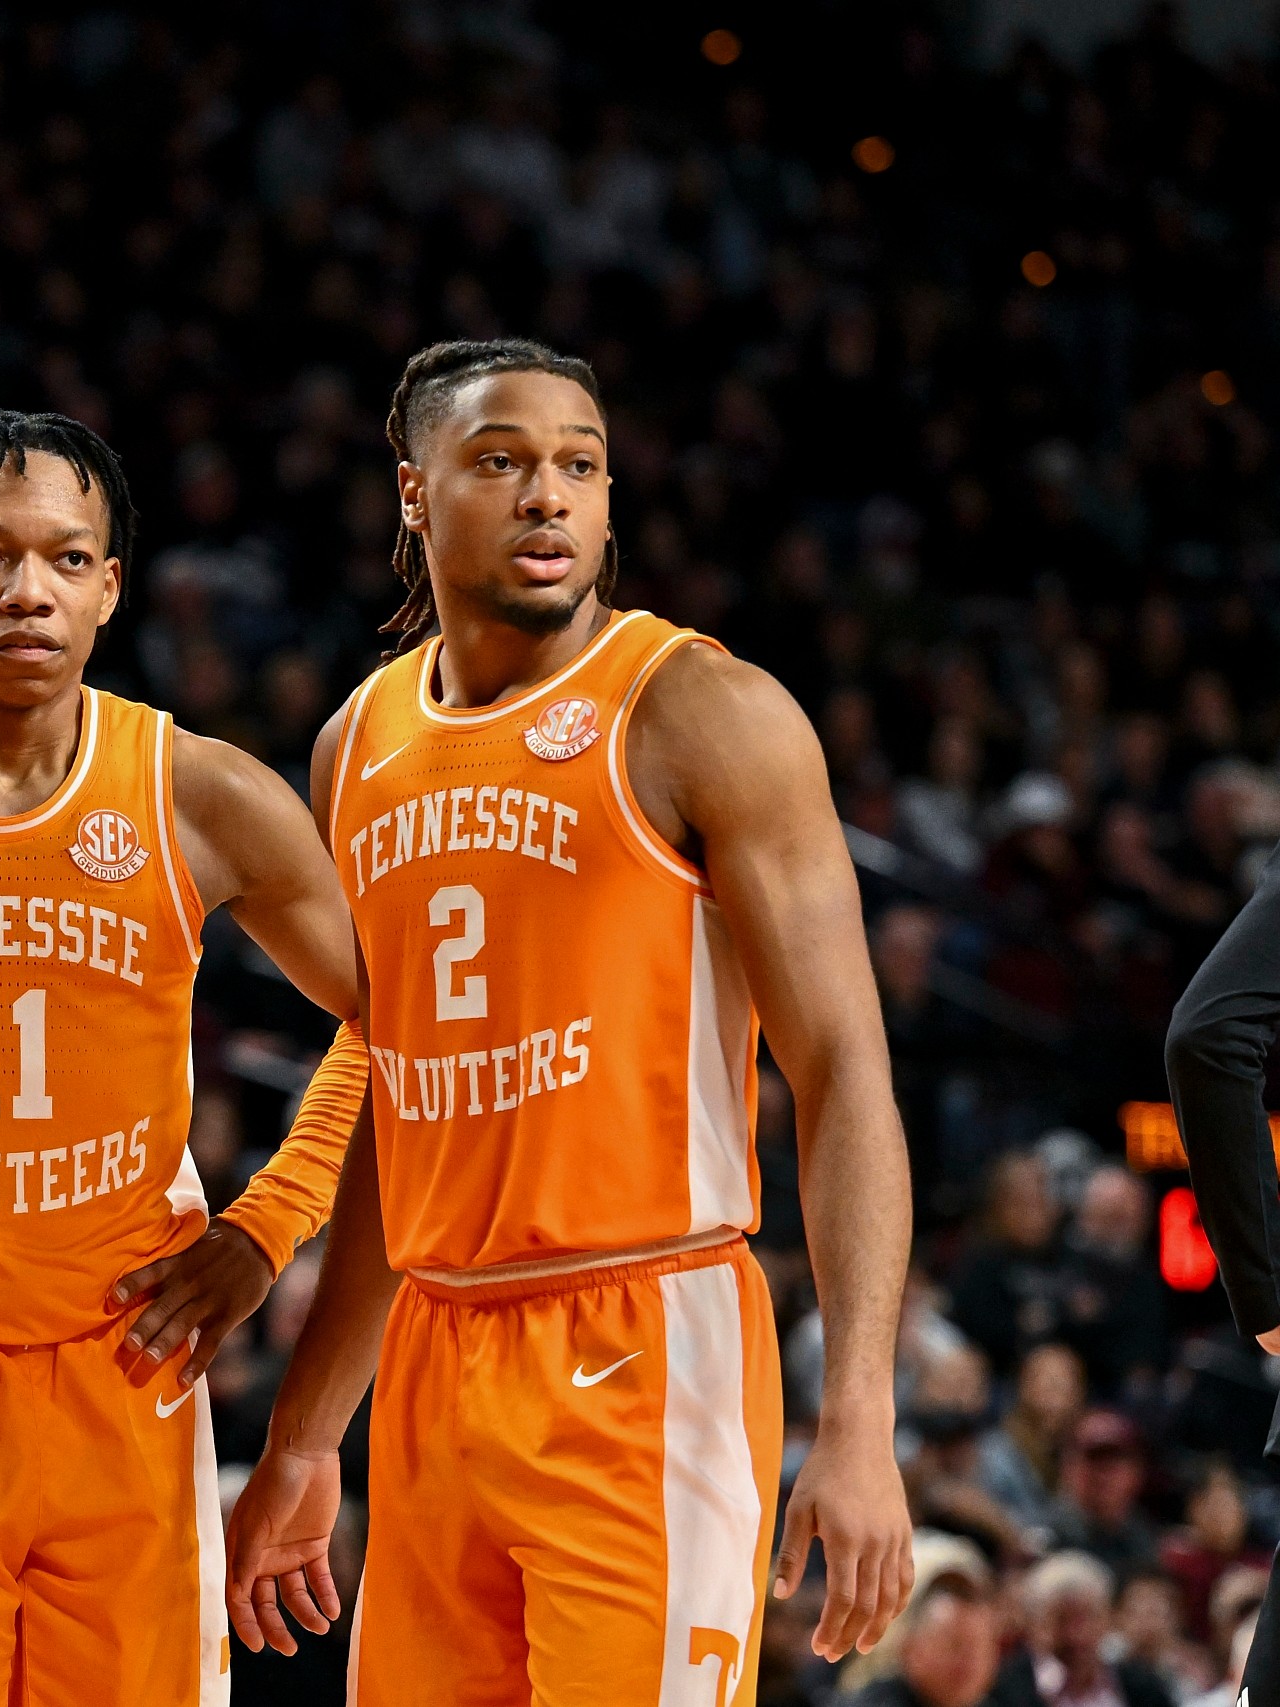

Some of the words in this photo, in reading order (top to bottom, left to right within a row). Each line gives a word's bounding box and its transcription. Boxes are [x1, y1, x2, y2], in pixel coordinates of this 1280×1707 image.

[542, 700, 593, 742] SEC
[528, 737, 587, 759] GRADUATE
[83, 813, 132, 862] SEC
[350, 786, 578, 898] TENNESSEE
[78, 856, 140, 879] GRADUATE
[428, 884, 488, 1022] 2
[370, 1016, 592, 1121] VLUNTERS
